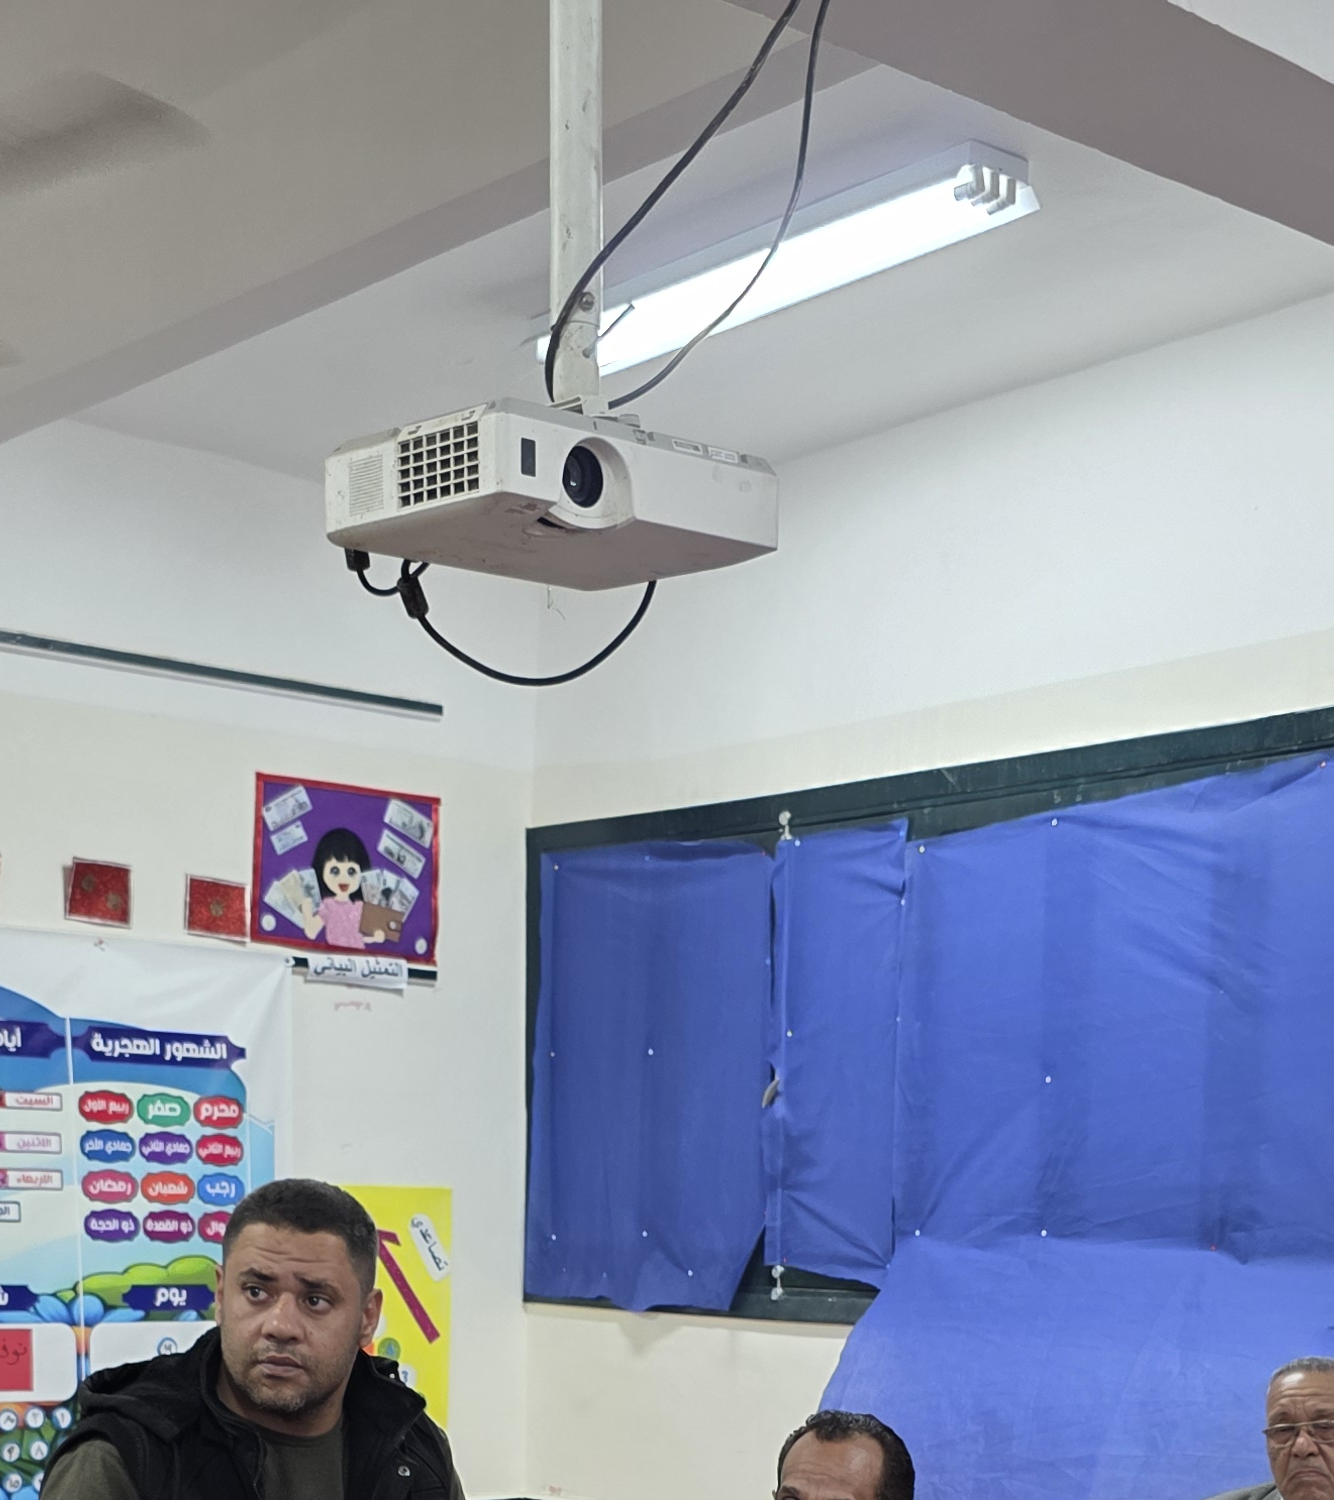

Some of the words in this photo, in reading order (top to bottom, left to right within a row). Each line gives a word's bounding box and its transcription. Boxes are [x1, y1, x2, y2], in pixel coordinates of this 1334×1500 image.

[361, 957, 403, 979] التمثيل
[91, 1032, 160, 1057] الهجرية
[164, 1039, 227, 1061] الشهور
[147, 1100, 181, 1119] صفر
[200, 1103, 239, 1120] محرم
[89, 1179, 132, 1195] رمضان
[148, 1179, 188, 1196] شعبان
[206, 1180, 236, 1198] رجب
[155, 1286, 187, 1306] يوم
